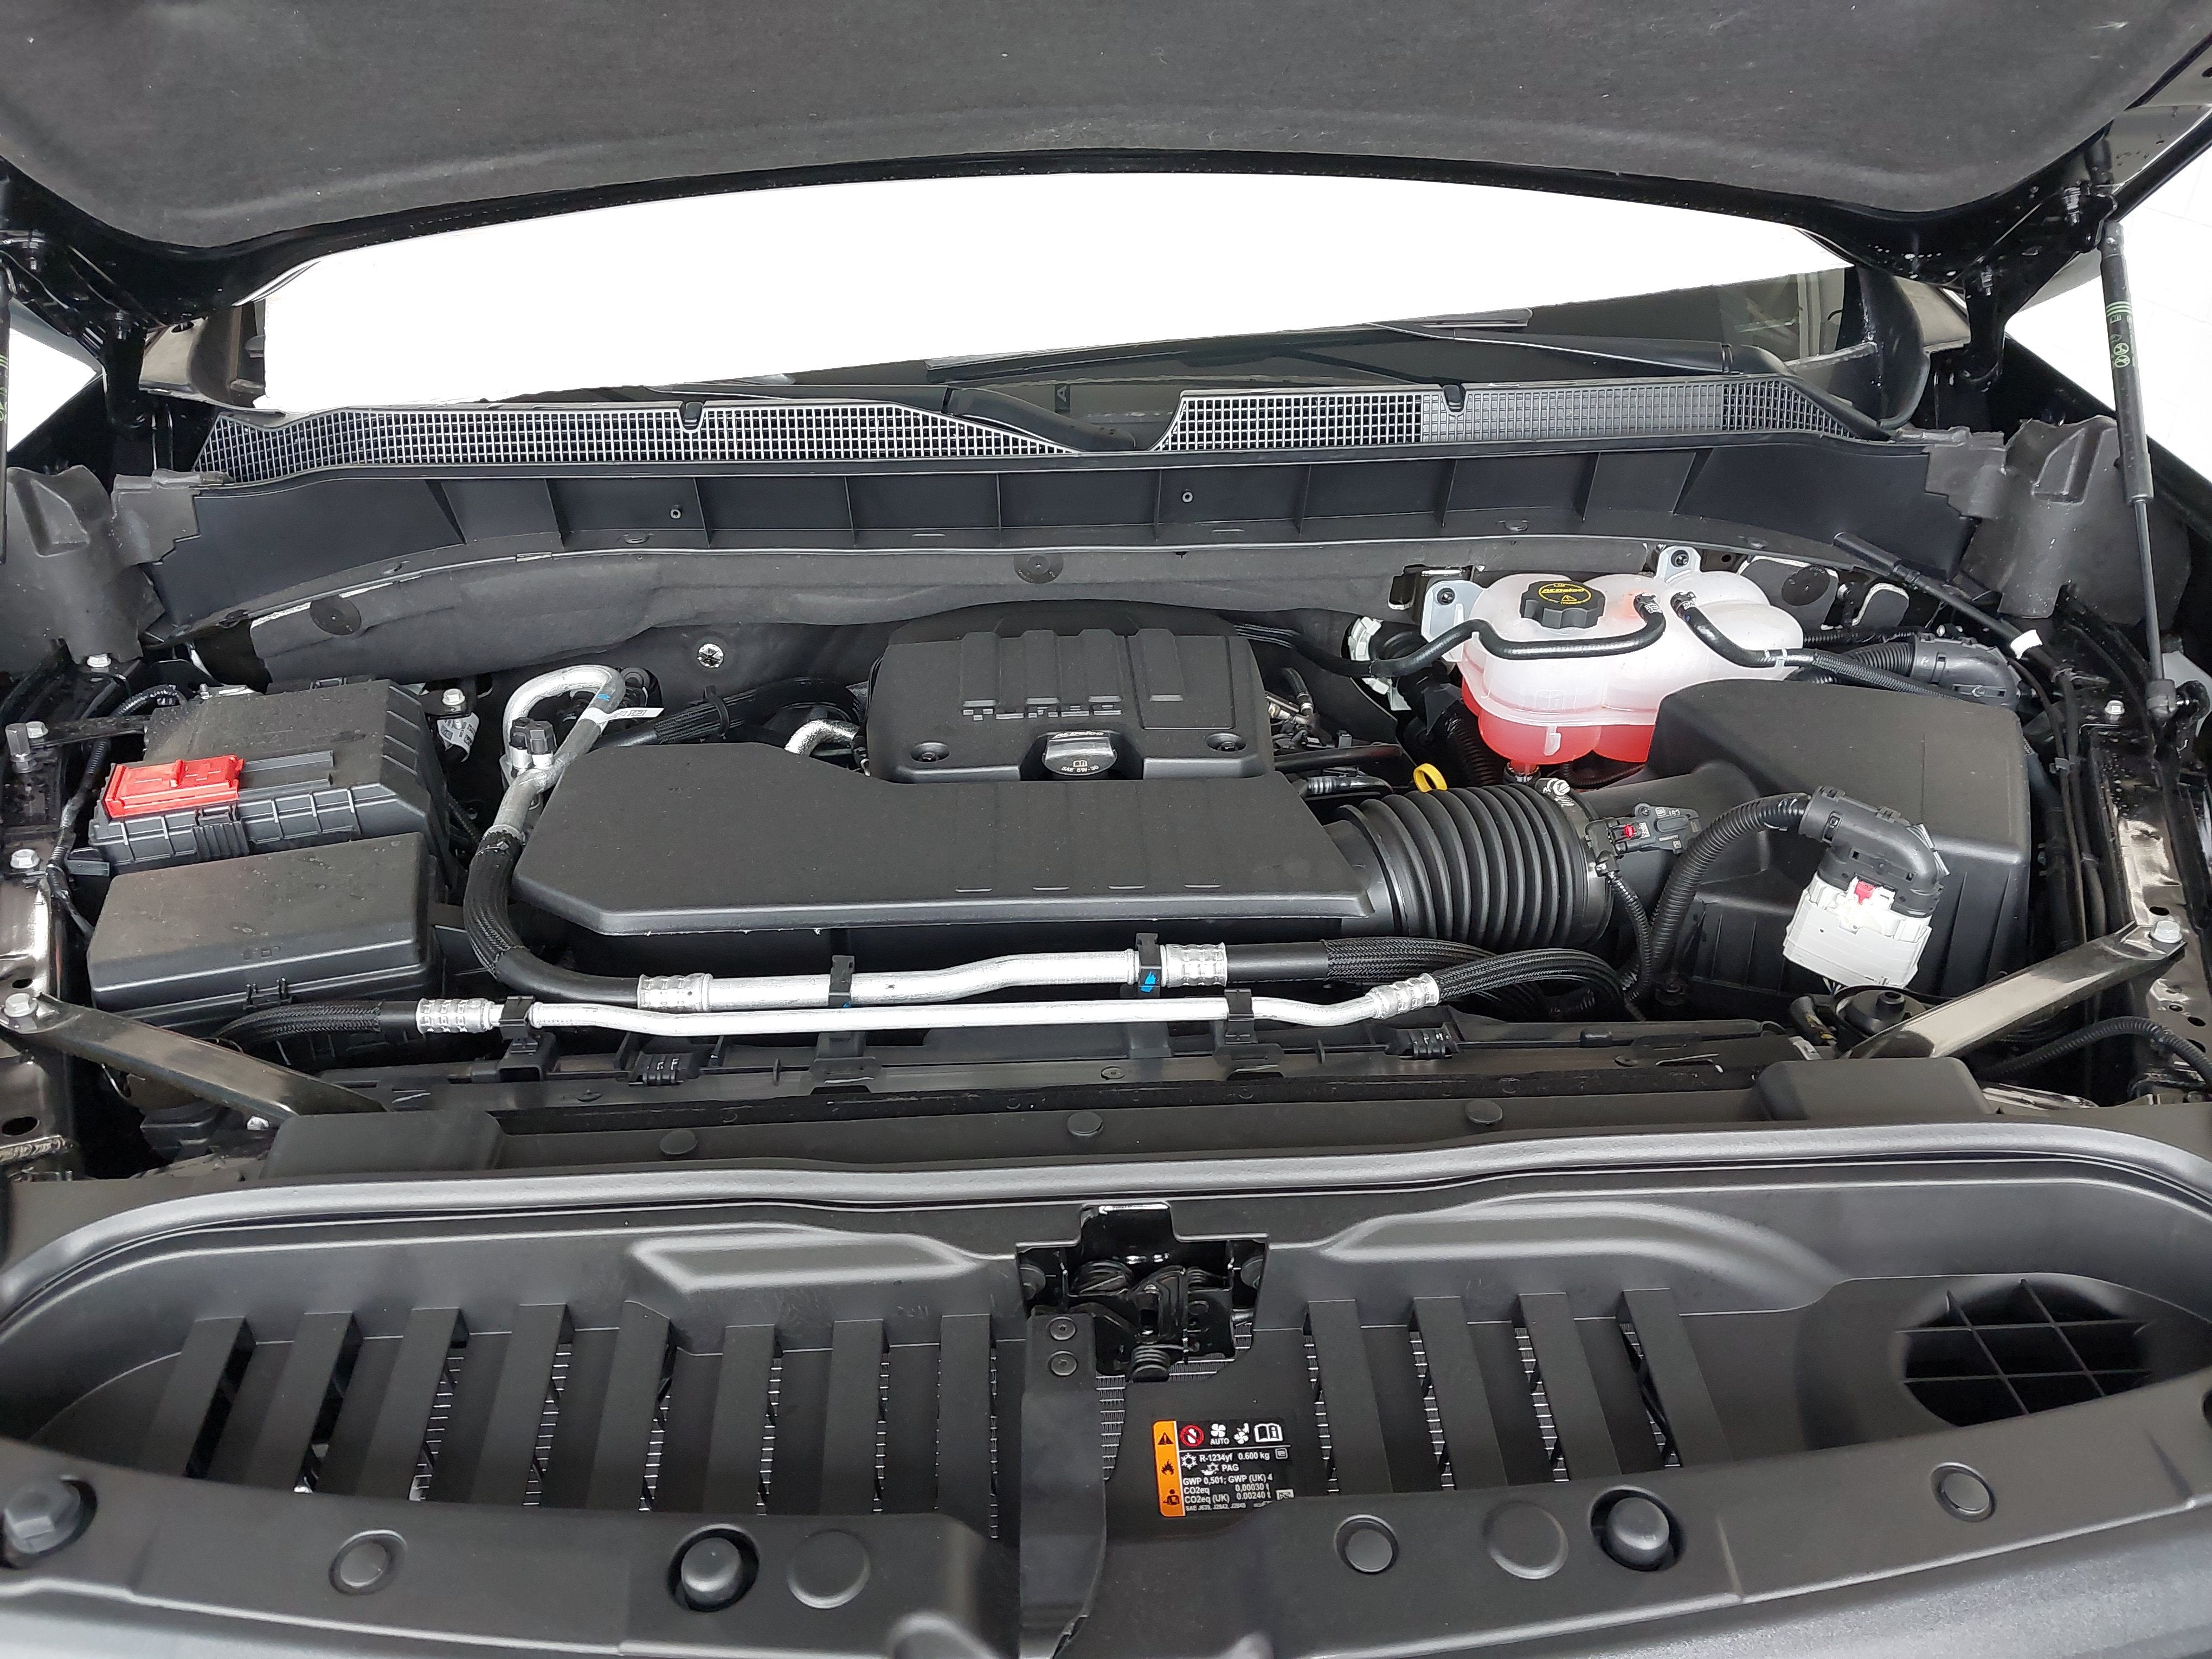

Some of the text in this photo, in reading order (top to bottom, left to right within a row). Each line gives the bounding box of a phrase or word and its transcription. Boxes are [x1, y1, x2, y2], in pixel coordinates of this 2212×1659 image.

[1199, 1451, 1270, 1463] R-1234yf 0.600 kg
[1221, 1464, 1239, 1472] PAG
[1183, 1477, 1202, 1486] GWP
[1203, 1476, 1227, 1486] 0,501;
[1228, 1475, 1247, 1483] GWP
[1249, 1474, 1266, 1483] (UK)
[1184, 1486, 1210, 1495] CO2eq
[1235, 1483, 1264, 1493] 0,00030
[1185, 1494, 1230, 1504] CO2eq (UK)
[1236, 1491, 1266, 1500] 0.00240
